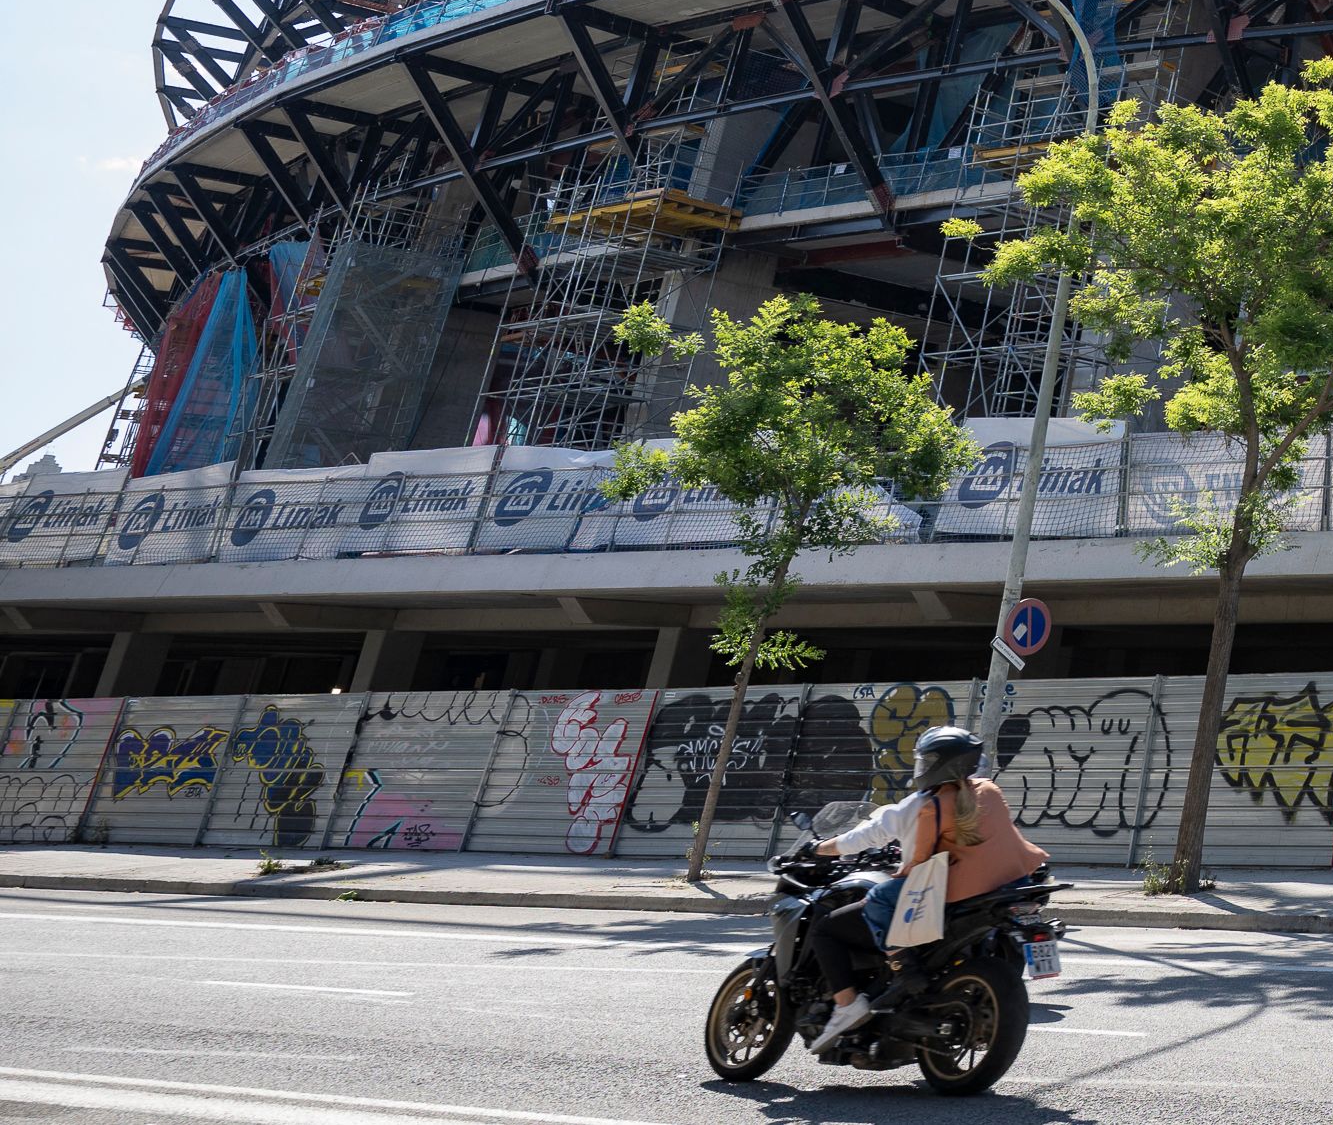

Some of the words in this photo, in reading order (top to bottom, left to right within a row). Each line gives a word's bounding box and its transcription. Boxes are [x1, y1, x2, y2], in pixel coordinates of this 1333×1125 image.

[1017, 457, 1104, 494] imak
[42, 497, 106, 528] Limak
[161, 494, 222, 533] Limak
[272, 497, 346, 529] Limak
[401, 479, 476, 514] Limak
